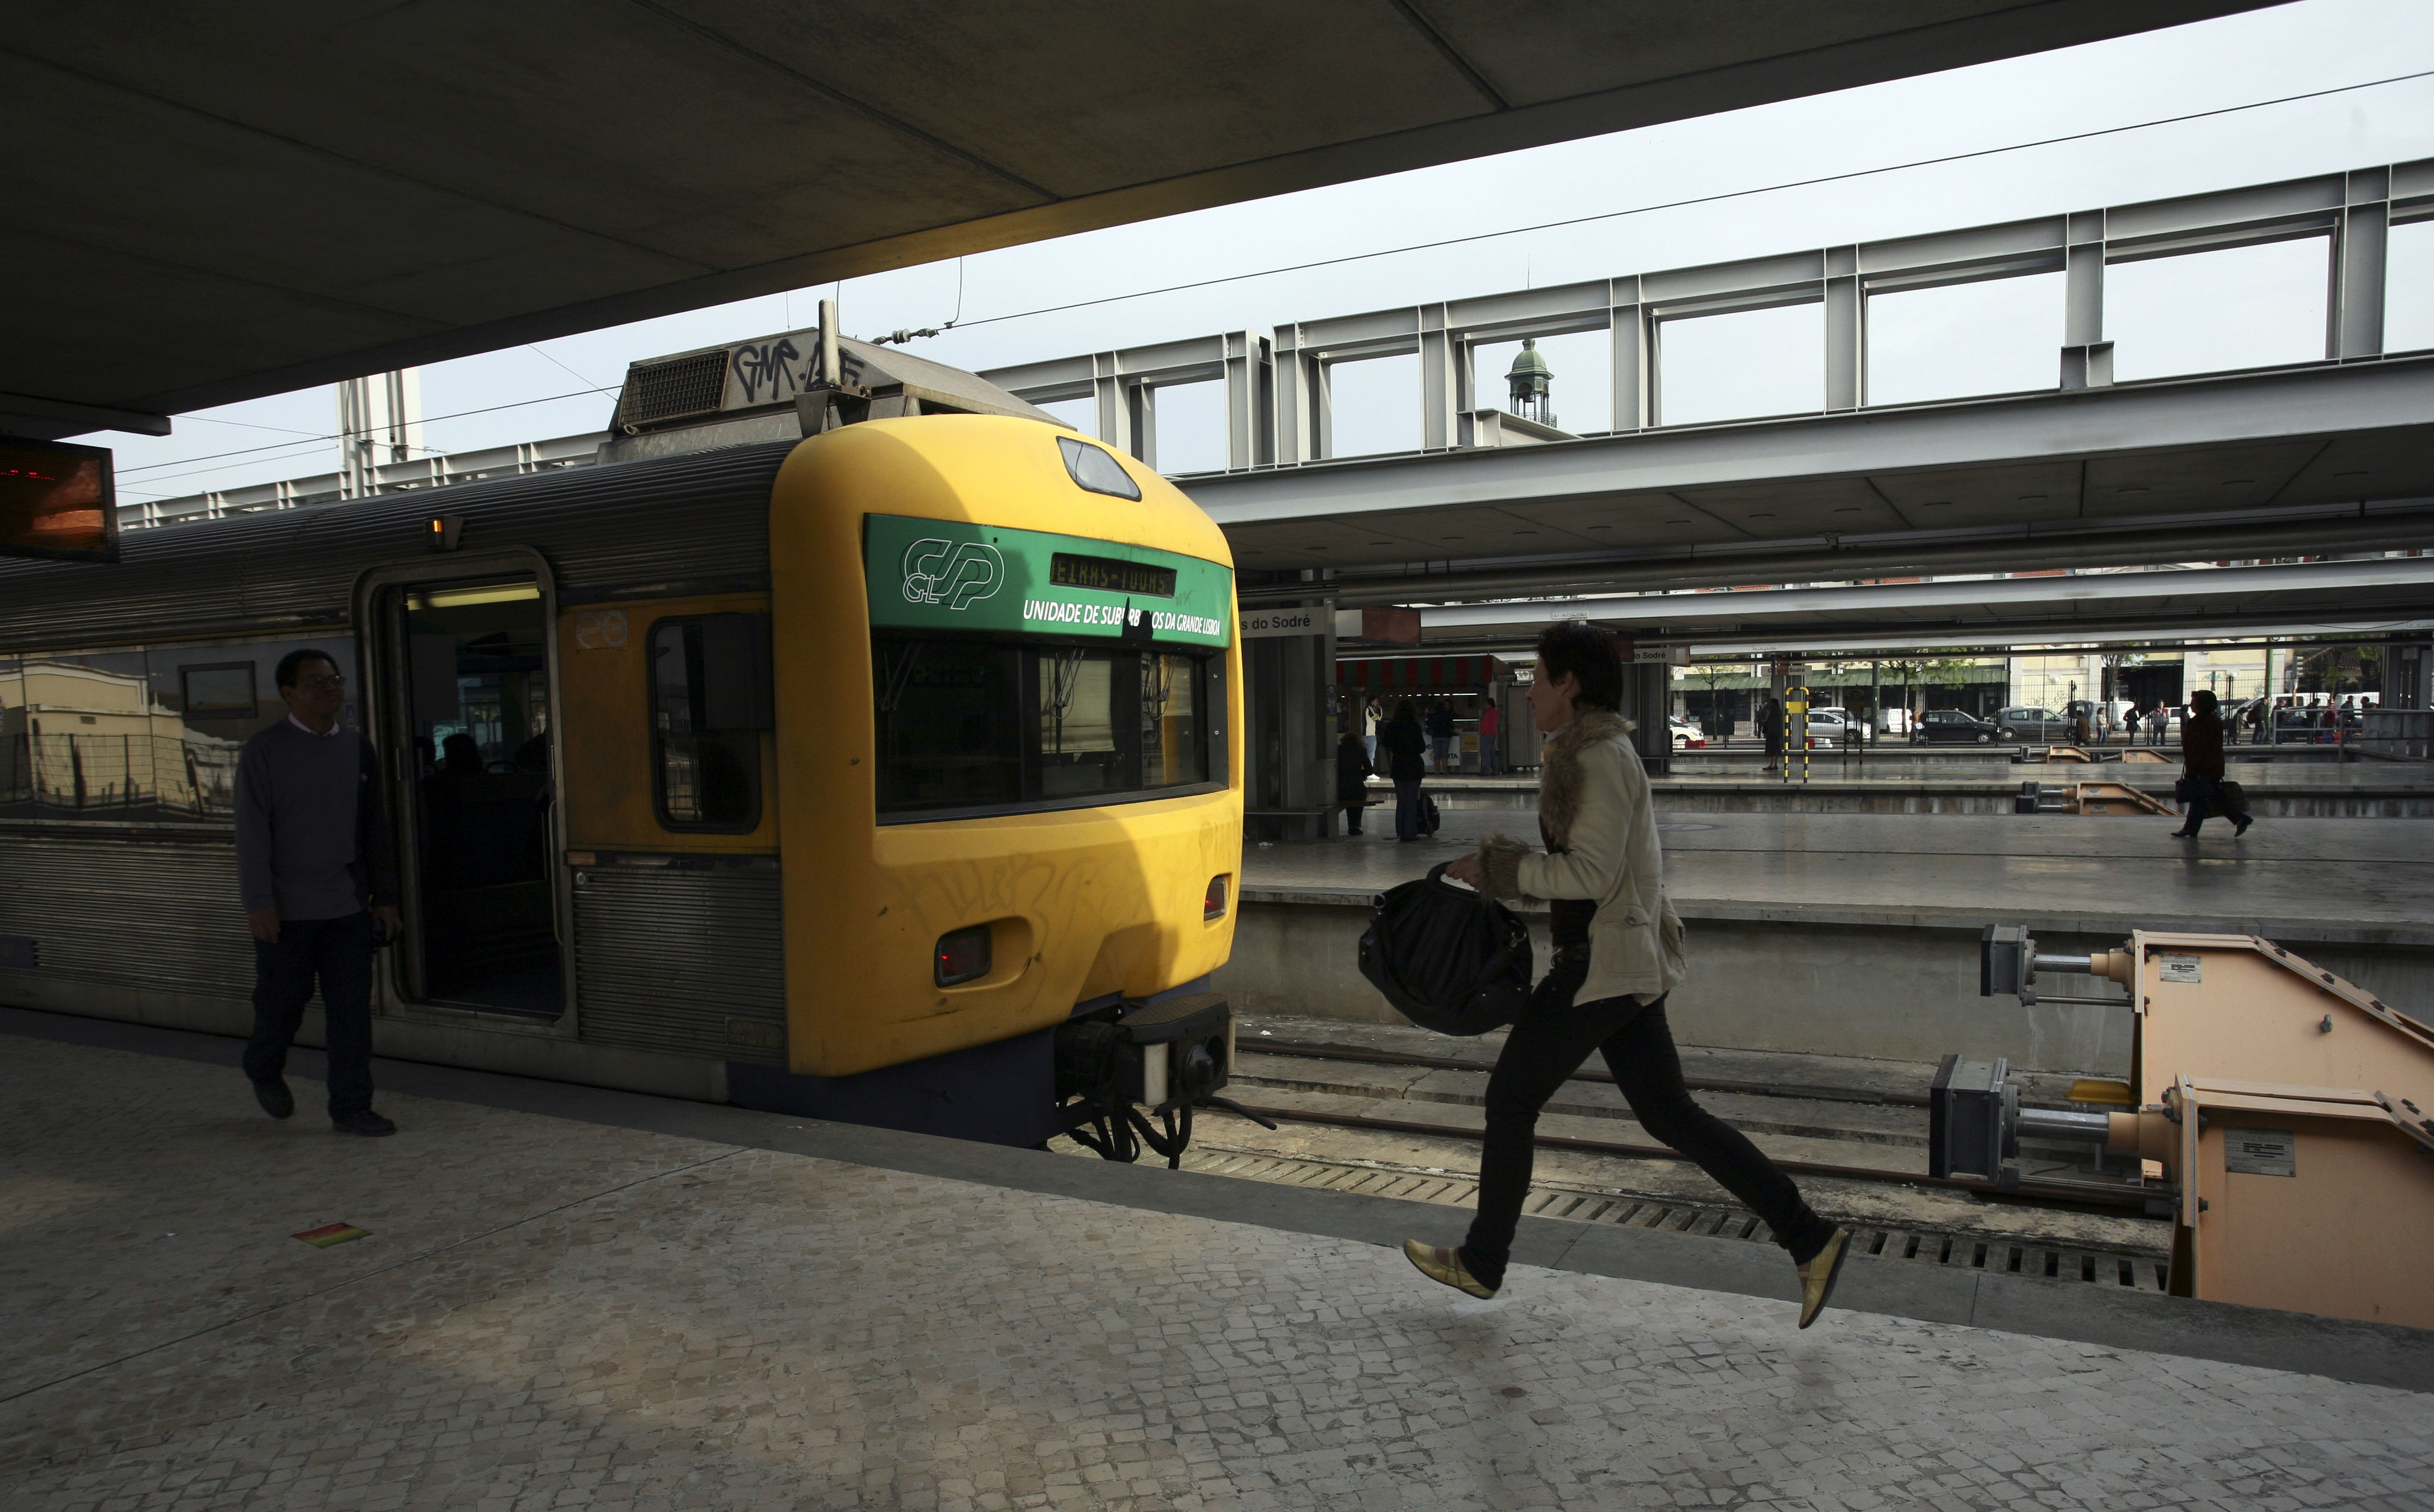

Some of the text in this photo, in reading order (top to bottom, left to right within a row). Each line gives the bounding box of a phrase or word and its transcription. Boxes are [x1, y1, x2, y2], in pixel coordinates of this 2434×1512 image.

[1023, 599, 1083, 624] UNIDADE
[1083, 604, 1100, 624] DE
[1100, 605, 1165, 630] SUBRBOS
[1165, 612, 1176, 630] DA
[1176, 614, 1204, 633] GRANDE
[1202, 618, 1221, 636] LISBOA
[1252, 618, 1268, 630] do
[1272, 613, 1310, 629] Sodré
[1643, 650, 1665, 659] Sodré
